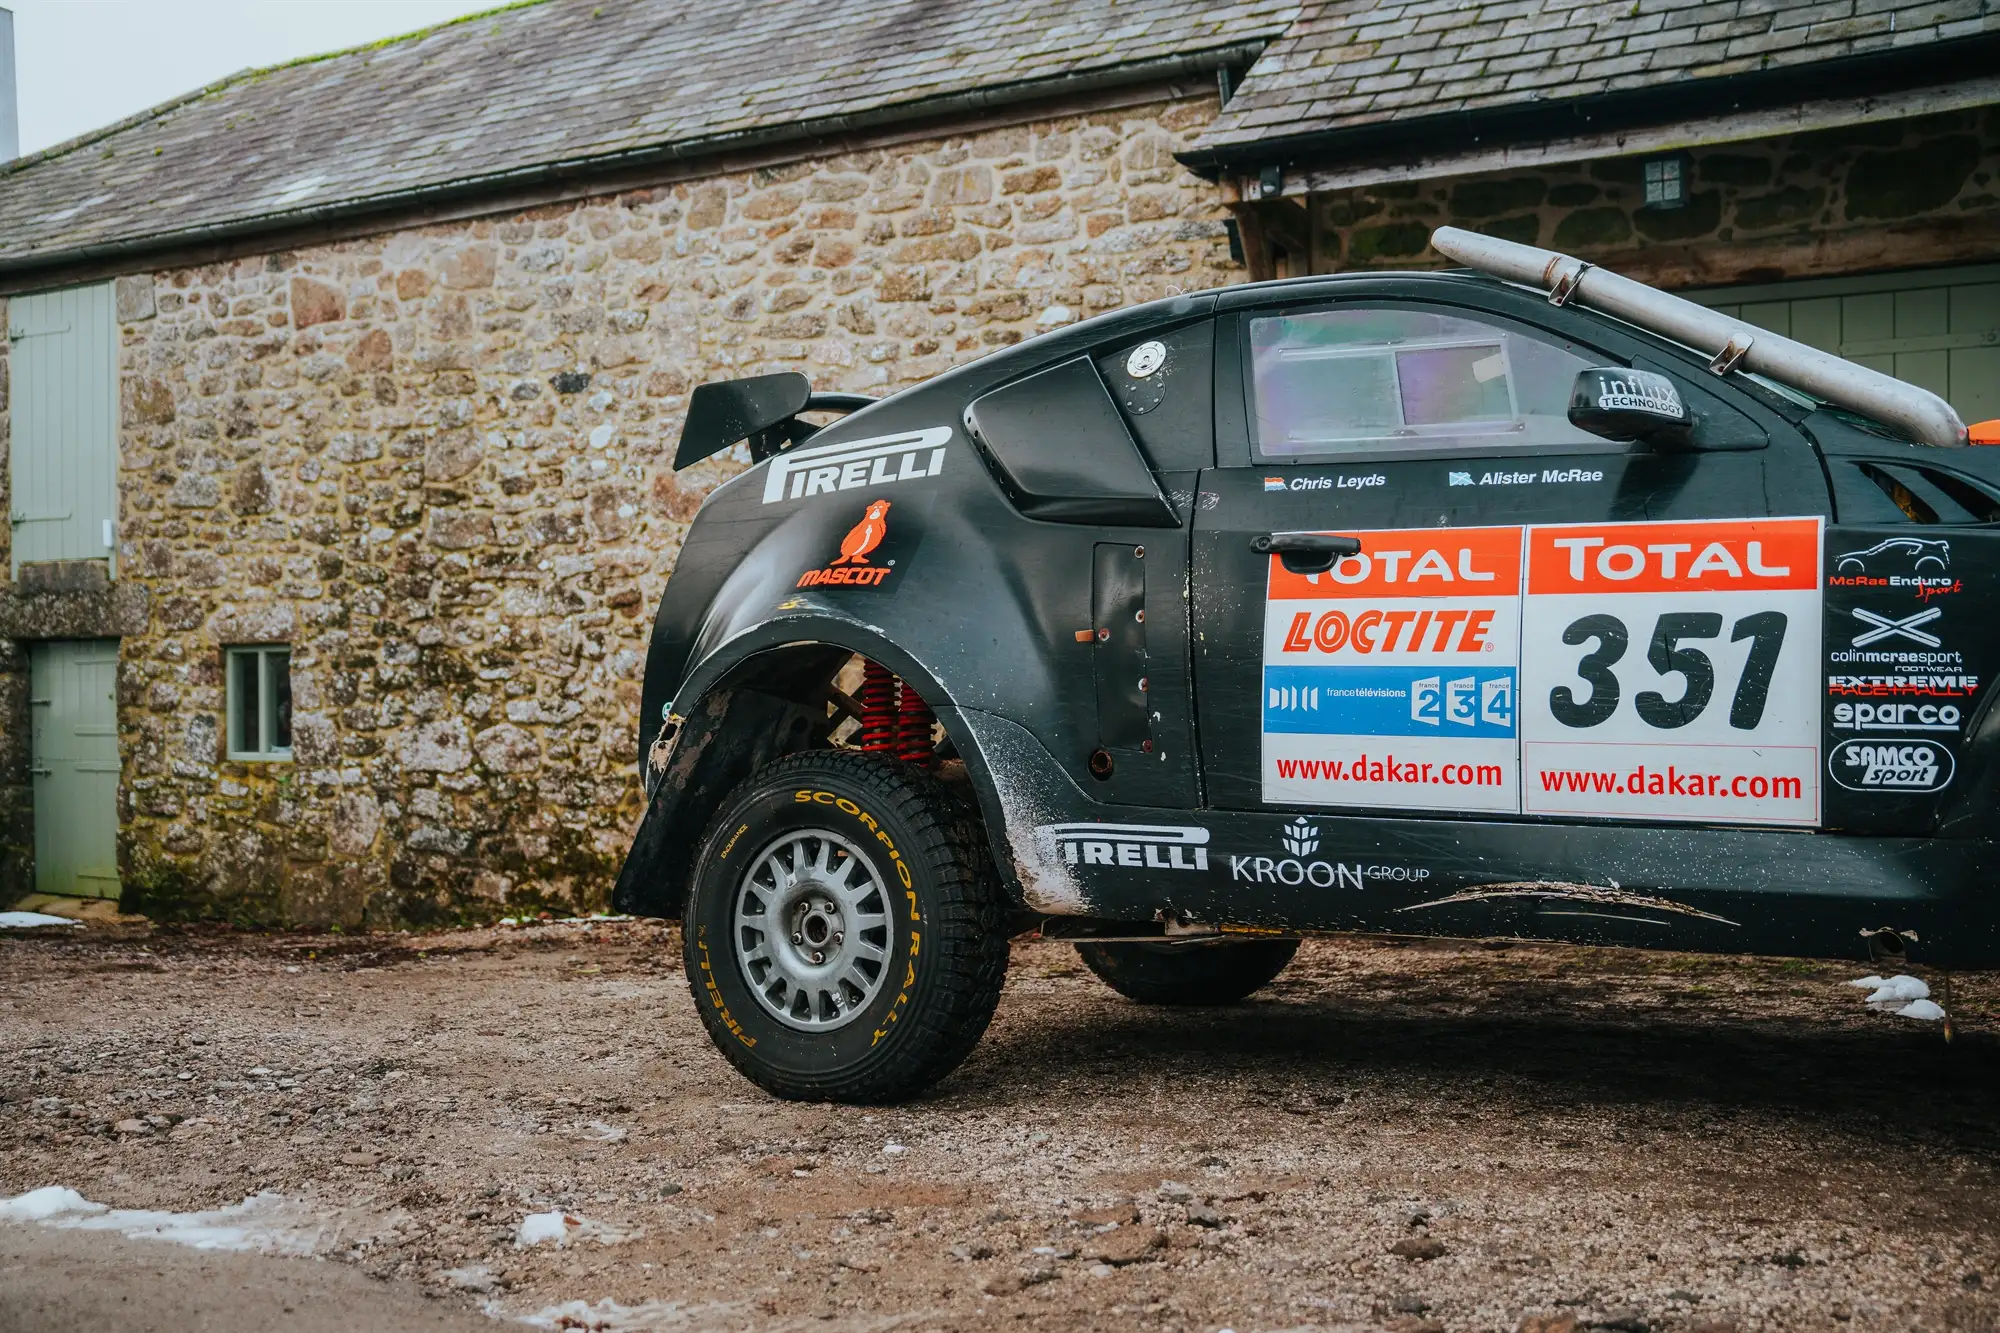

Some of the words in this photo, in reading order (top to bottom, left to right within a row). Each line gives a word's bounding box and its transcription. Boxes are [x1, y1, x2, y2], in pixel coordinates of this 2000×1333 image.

[1602, 397, 1681, 414] TECHNOLOGY
[762, 426, 953, 504] PIRELLI
[1479, 472, 1537, 485] Alister
[1541, 469, 1604, 483] McRae
[1290, 477, 1332, 490] Chris
[1337, 474, 1386, 490] Leyds
[1306, 548, 1495, 585] OTAL
[1554, 537, 1790, 581] TOTAL
[796, 567, 891, 587] MASCOT
[1829, 576, 1888, 586] McRae
[1890, 576, 1952, 586] Enduro
[1282, 610, 1496, 654] LOCTITE
[1549, 611, 1788, 730] 351
[1831, 649, 1963, 665] colinmcraesport
[1829, 676, 1979, 688] EXTREME
[1418, 689, 1440, 717] 2
[1453, 690, 1476, 718] 3
[1487, 690, 1511, 719] 4
[1833, 702, 1960, 730] sparco
[1277, 754, 1502, 786] www.dakar.com
[1845, 746, 1935, 767] SAMCO
[1540, 766, 1801, 799] www.dakar.com
[1870, 768, 1929, 783] sport
[1231, 855, 1364, 890] KROON
[1367, 865, 1430, 882] GROUP
[795, 790, 921, 921] SCORPION
[871, 931, 920, 1047] RALLY
